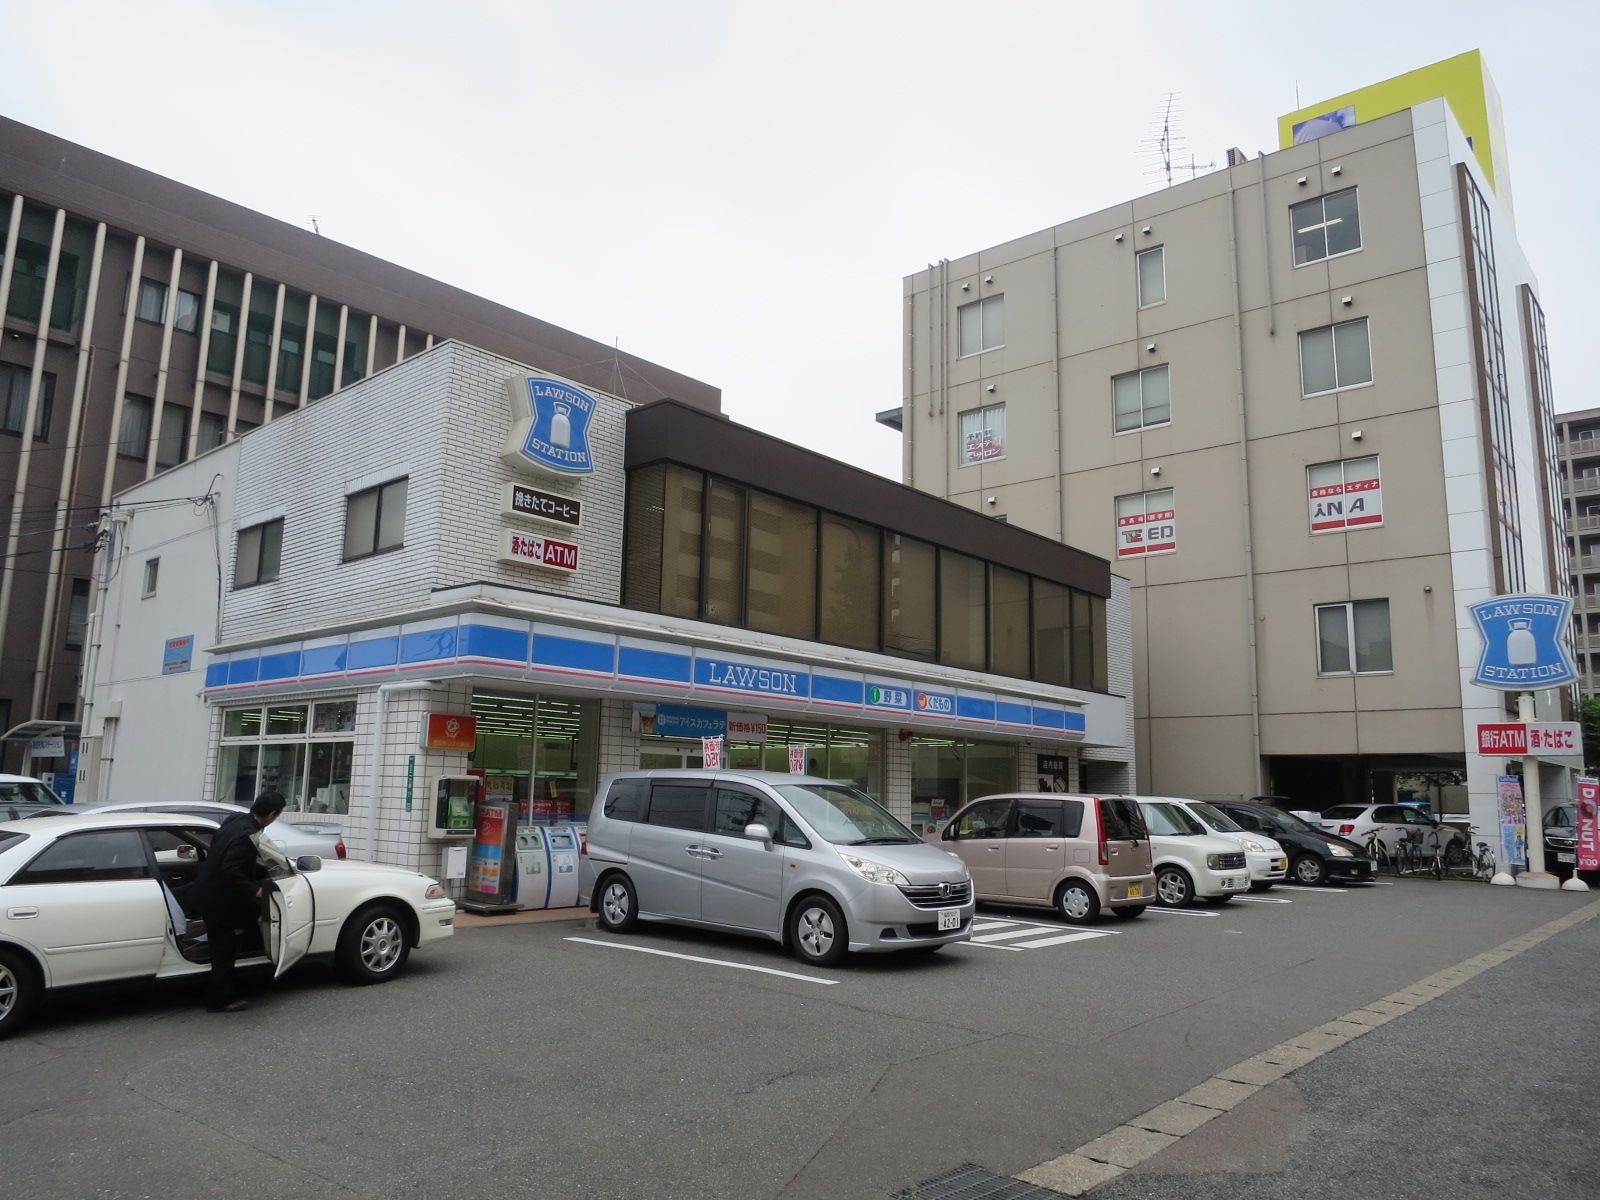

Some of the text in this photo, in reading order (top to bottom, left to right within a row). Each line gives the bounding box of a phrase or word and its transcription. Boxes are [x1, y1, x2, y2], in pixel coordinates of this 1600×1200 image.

[534, 385, 590, 412] LAWSON
[531, 437, 587, 463] STATION
[515, 490, 578, 518] 挽きたてコーヒー
[545, 544, 575, 566] ATM
[1480, 603, 1559, 621] LAWSON
[709, 662, 796, 693] LAWSON
[1484, 663, 1563, 679] STATION
[928, 696, 950, 710] くだもの
[1481, 730, 1525, 748] 銀行ATM
